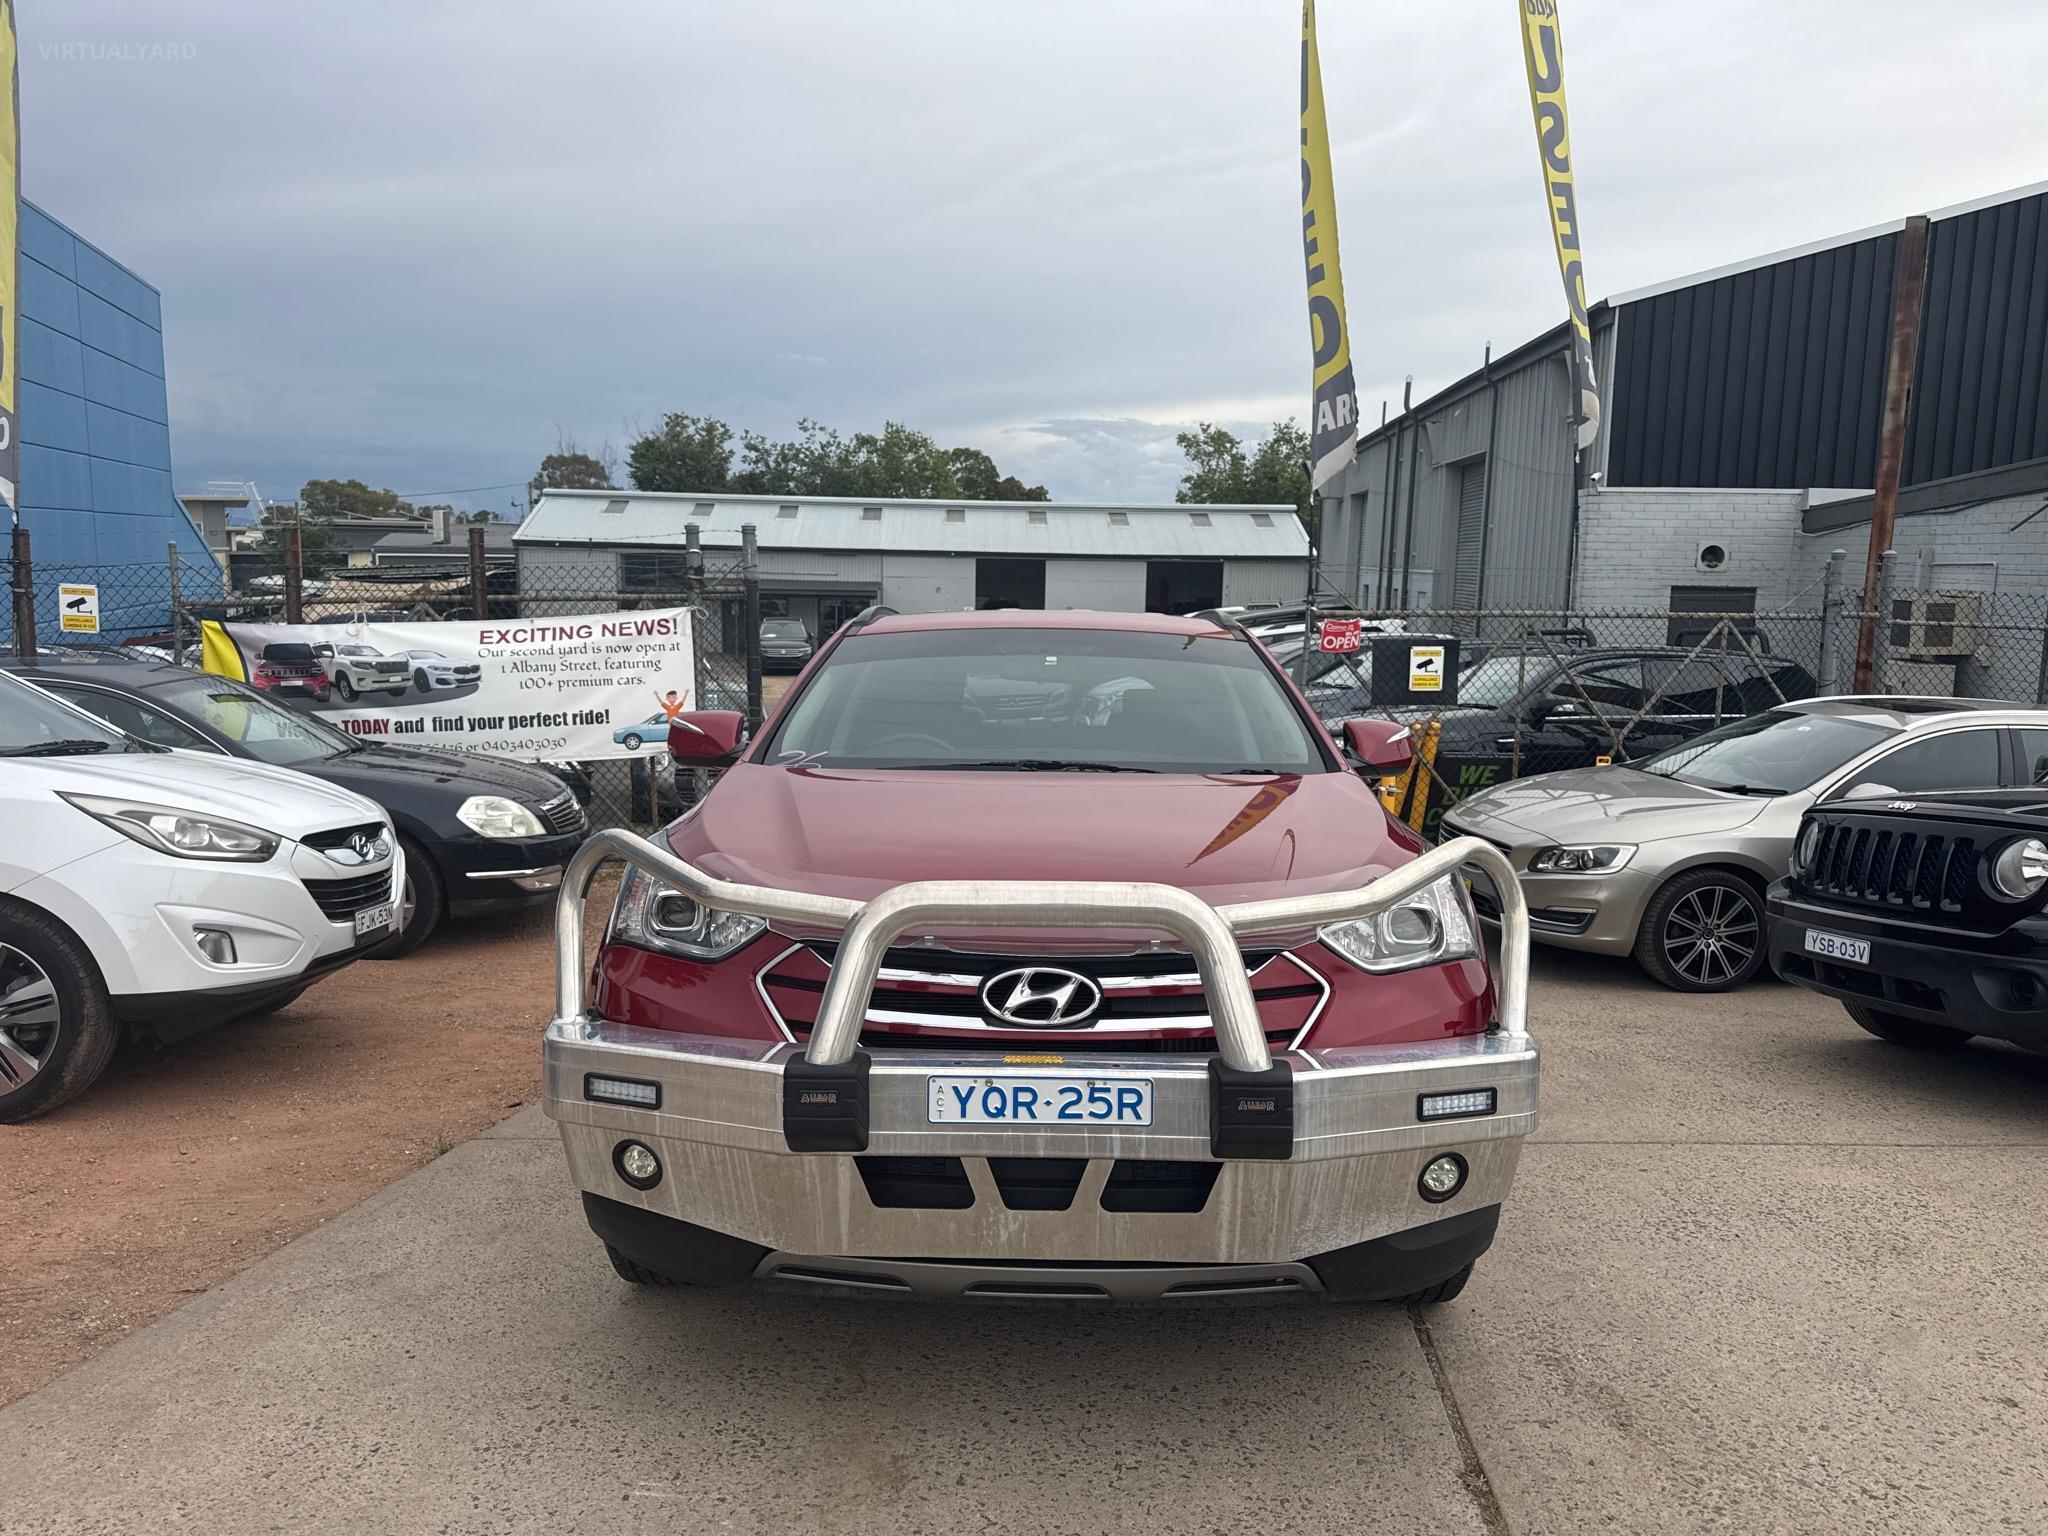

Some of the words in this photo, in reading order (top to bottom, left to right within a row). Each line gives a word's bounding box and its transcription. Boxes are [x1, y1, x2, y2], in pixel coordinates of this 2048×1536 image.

[479, 624, 593, 645] EXCITING
[601, 617, 679, 638] NEWS!
[478, 647, 507, 658] Our
[510, 643, 554, 657] second
[558, 642, 588, 660] yard
[591, 642, 602, 654] is
[605, 643, 633, 654] now
[635, 643, 665, 657] open
[667, 641, 681, 652] at
[1323, 634, 1359, 649] OPEN
[510, 660, 556, 676] Albany
[560, 659, 601, 673] Street,
[604, 657, 662, 672] featuring
[519, 677, 552, 690] 100+
[558, 675, 614, 692] premium
[617, 675, 646, 686] cars.
[341, 718, 390, 735] TODAY
[394, 717, 425, 733] and
[432, 715, 464, 732] find
[467, 716, 505, 732] your
[508, 711, 569, 730] perfect
[572, 709, 610, 726] ride!
[466, 744, 479, 752] or
[481, 737, 567, 753] 0403403030
[1459, 765, 1500, 785] WE
[1888, 800, 1917, 811] Jeep
